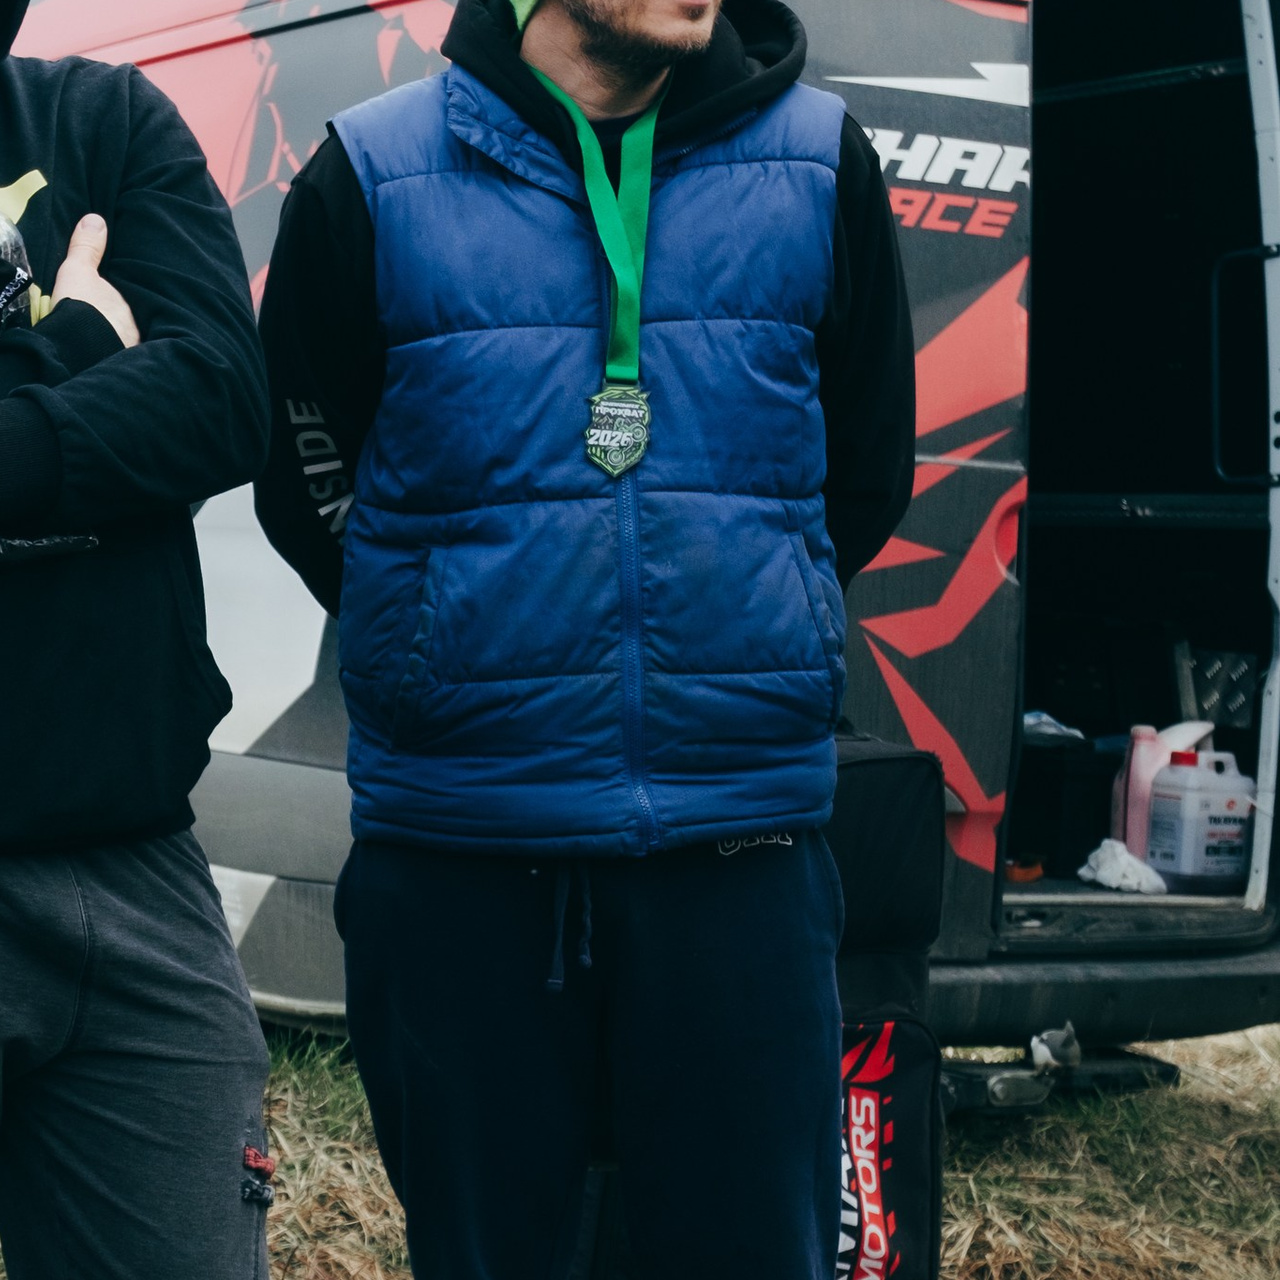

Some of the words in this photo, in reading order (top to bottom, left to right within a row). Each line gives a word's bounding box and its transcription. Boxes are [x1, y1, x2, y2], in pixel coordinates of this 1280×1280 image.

[862, 126, 1030, 193] HAR
[888, 186, 1019, 239] ACE
[587, 428, 633, 447] 2026
[286, 398, 355, 546] NSIDE
